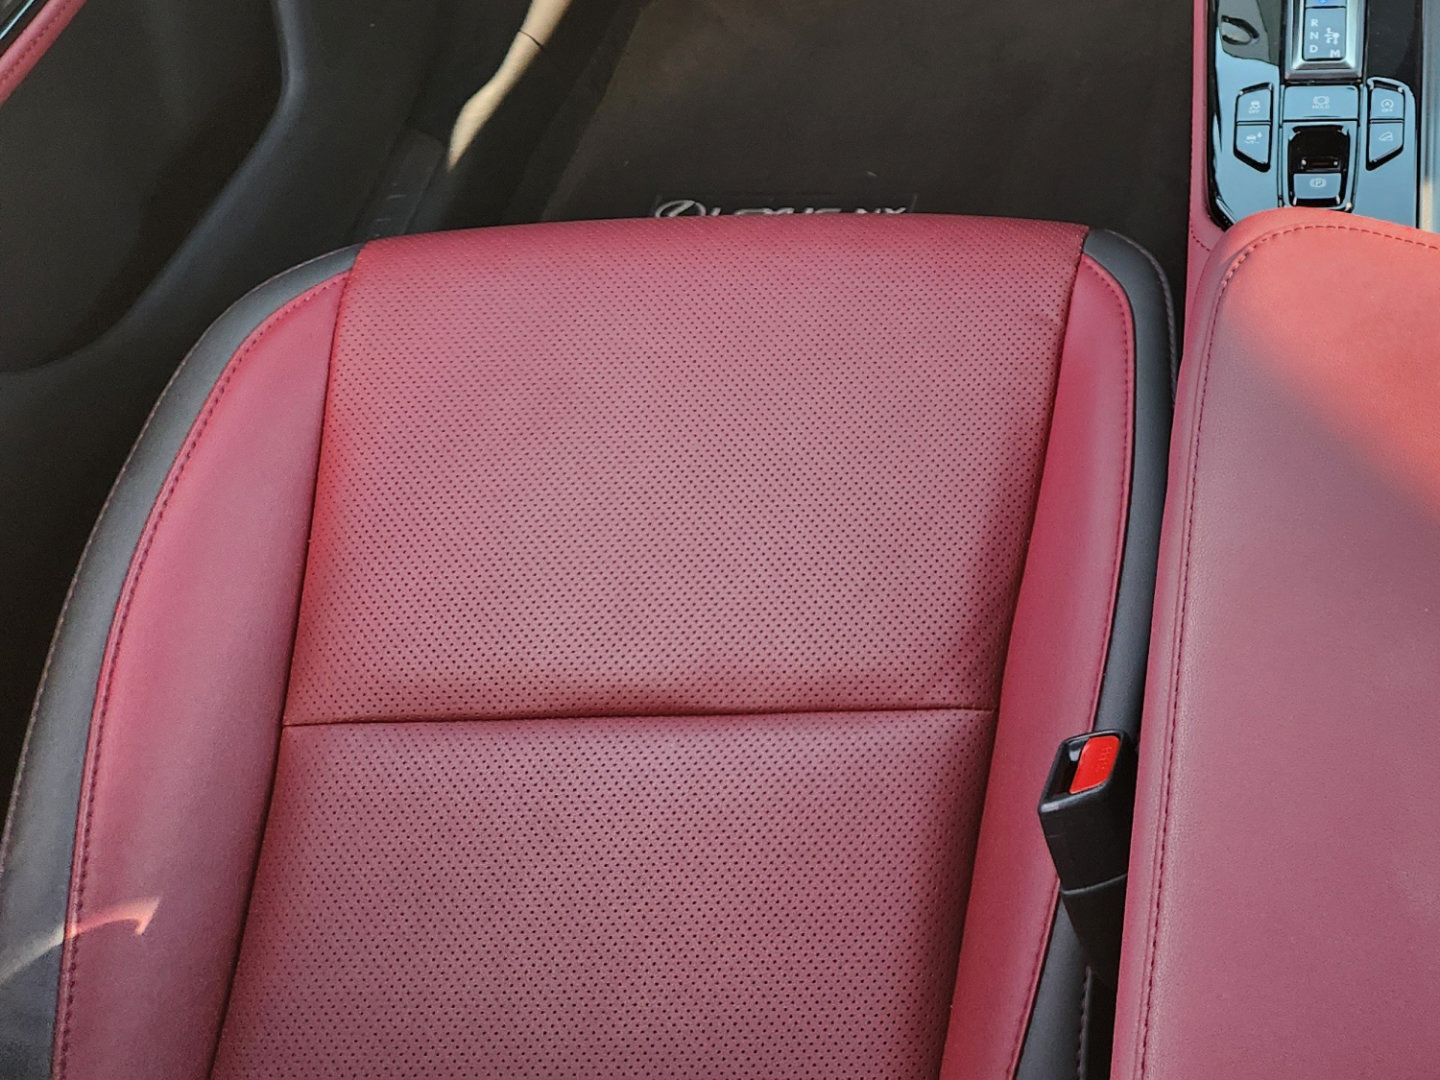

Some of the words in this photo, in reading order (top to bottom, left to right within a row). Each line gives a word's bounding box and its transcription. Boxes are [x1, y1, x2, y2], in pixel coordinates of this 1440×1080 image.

[1310, 18, 1319, 28] R
[1310, 31, 1319, 41] N
[1309, 44, 1319, 54] D
[1330, 48, 1341, 58] M
